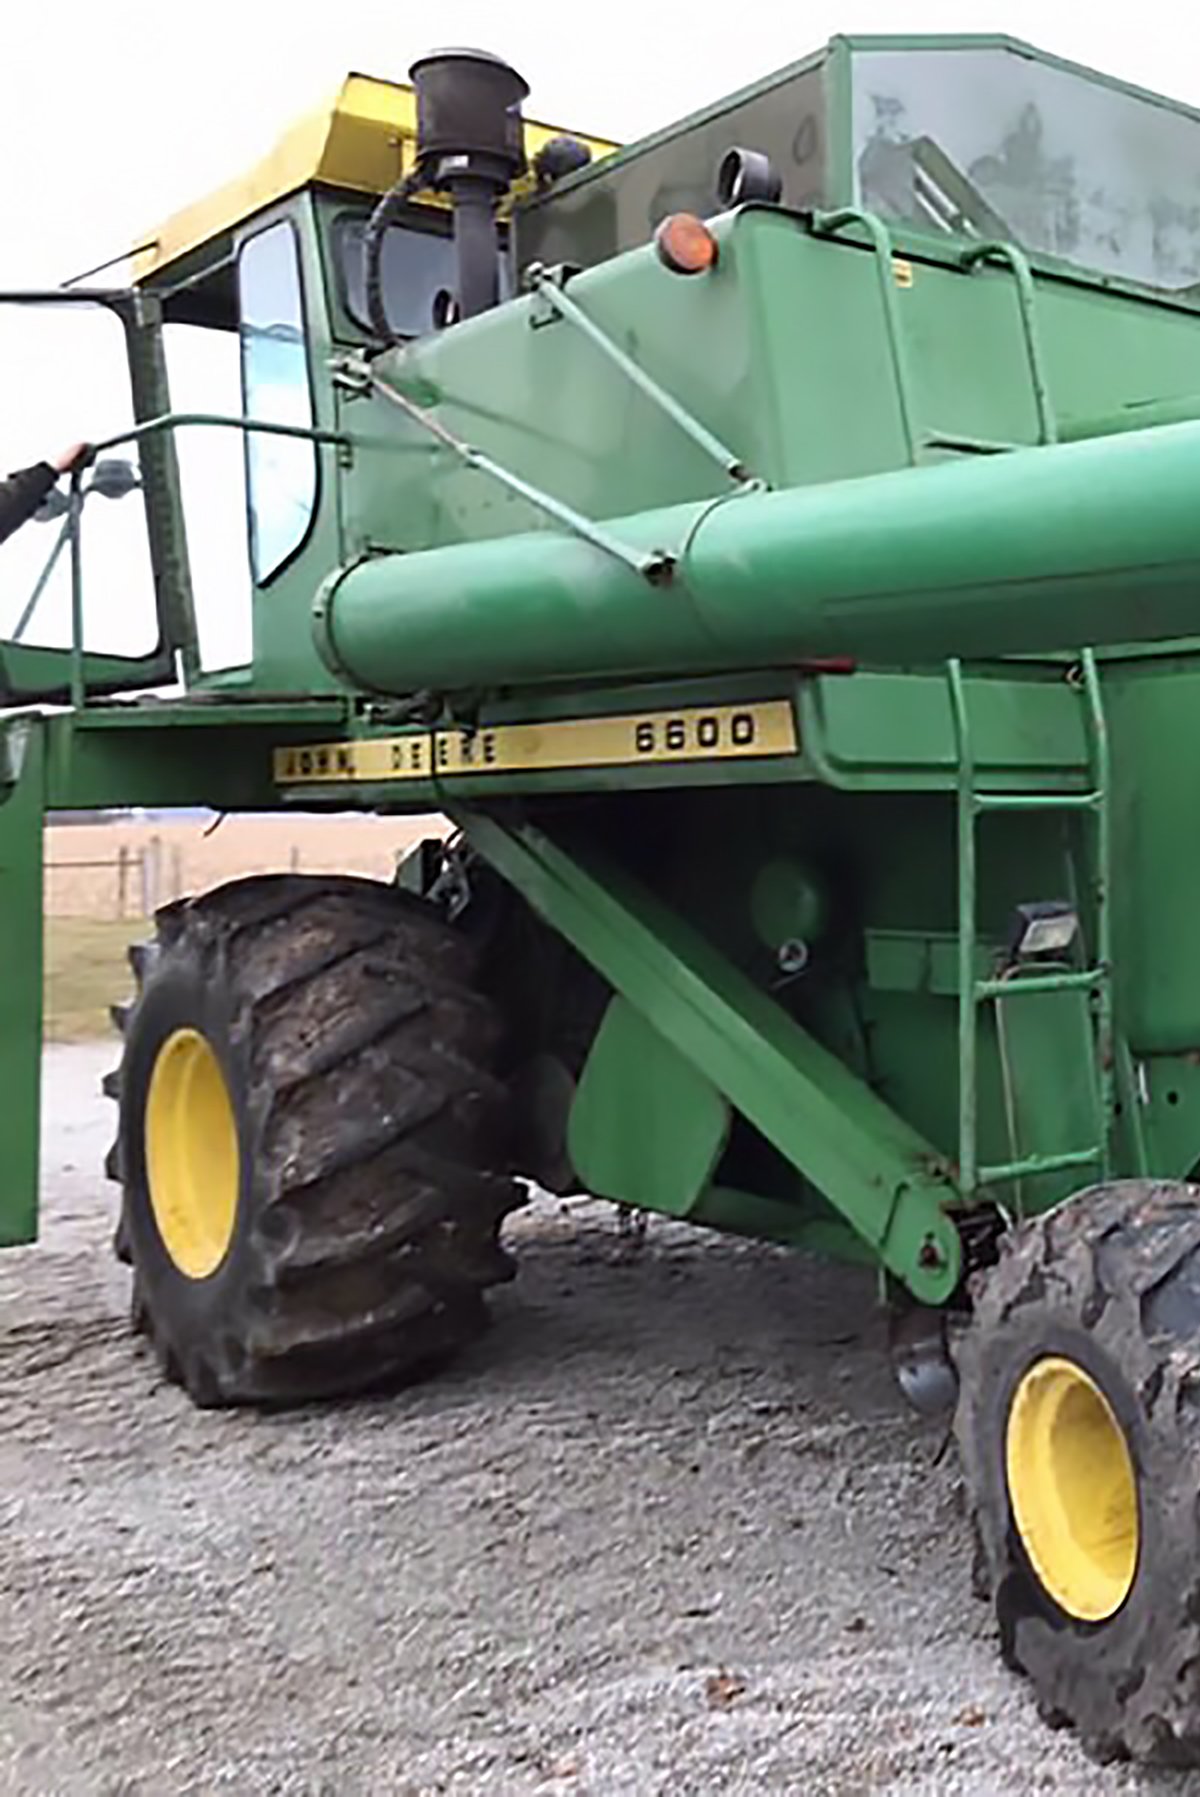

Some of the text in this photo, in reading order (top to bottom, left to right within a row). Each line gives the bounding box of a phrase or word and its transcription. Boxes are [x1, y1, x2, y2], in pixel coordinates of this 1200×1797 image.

[285, 713, 754, 776] JOHN DEERE 6600
